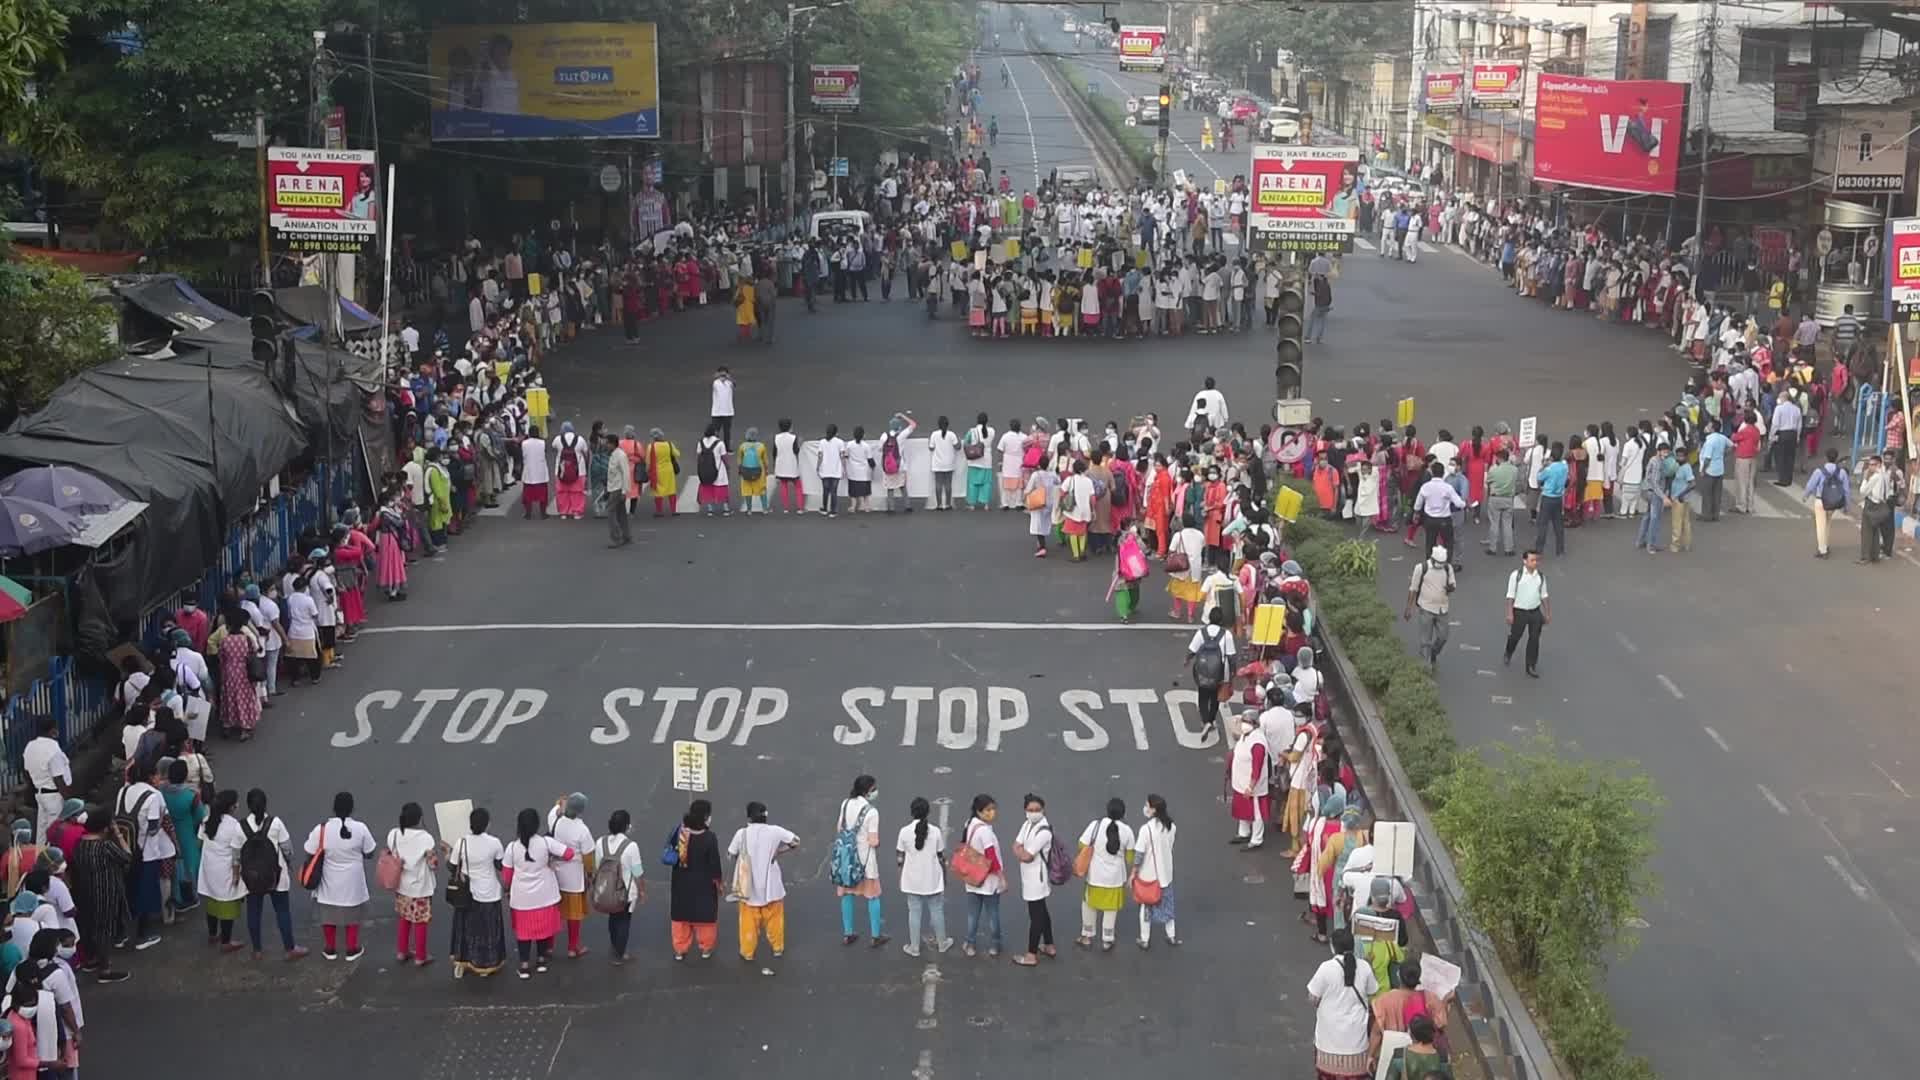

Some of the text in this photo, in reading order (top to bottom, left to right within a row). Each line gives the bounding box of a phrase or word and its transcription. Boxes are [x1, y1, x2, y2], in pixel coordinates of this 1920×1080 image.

[559, 70, 609, 82] TUTOPIA
[280, 151, 297, 159] YOU
[326, 153, 362, 161] REACHED
[279, 178, 341, 191] ARENA
[1262, 176, 1323, 189] ARENA
[1838, 176, 1902, 188] 9830012199
[279, 194, 342, 204] ANIMATION
[1260, 193, 1324, 203] ANIMATION
[284, 221, 368, 231] ANIMATION VFX
[1267, 219, 1346, 230] GRAPHICS WEB
[289, 232, 355, 241] CHOWRINGHEE
[358, 234, 370, 242] RD
[1255, 232, 1348, 241] 60 CHOWRINGHEE RD
[330, 688, 549, 748] STOP
[590, 687, 789, 746] STOP
[833, 686, 1029, 752] STOP
[1060, 688, 1244, 752] STO
